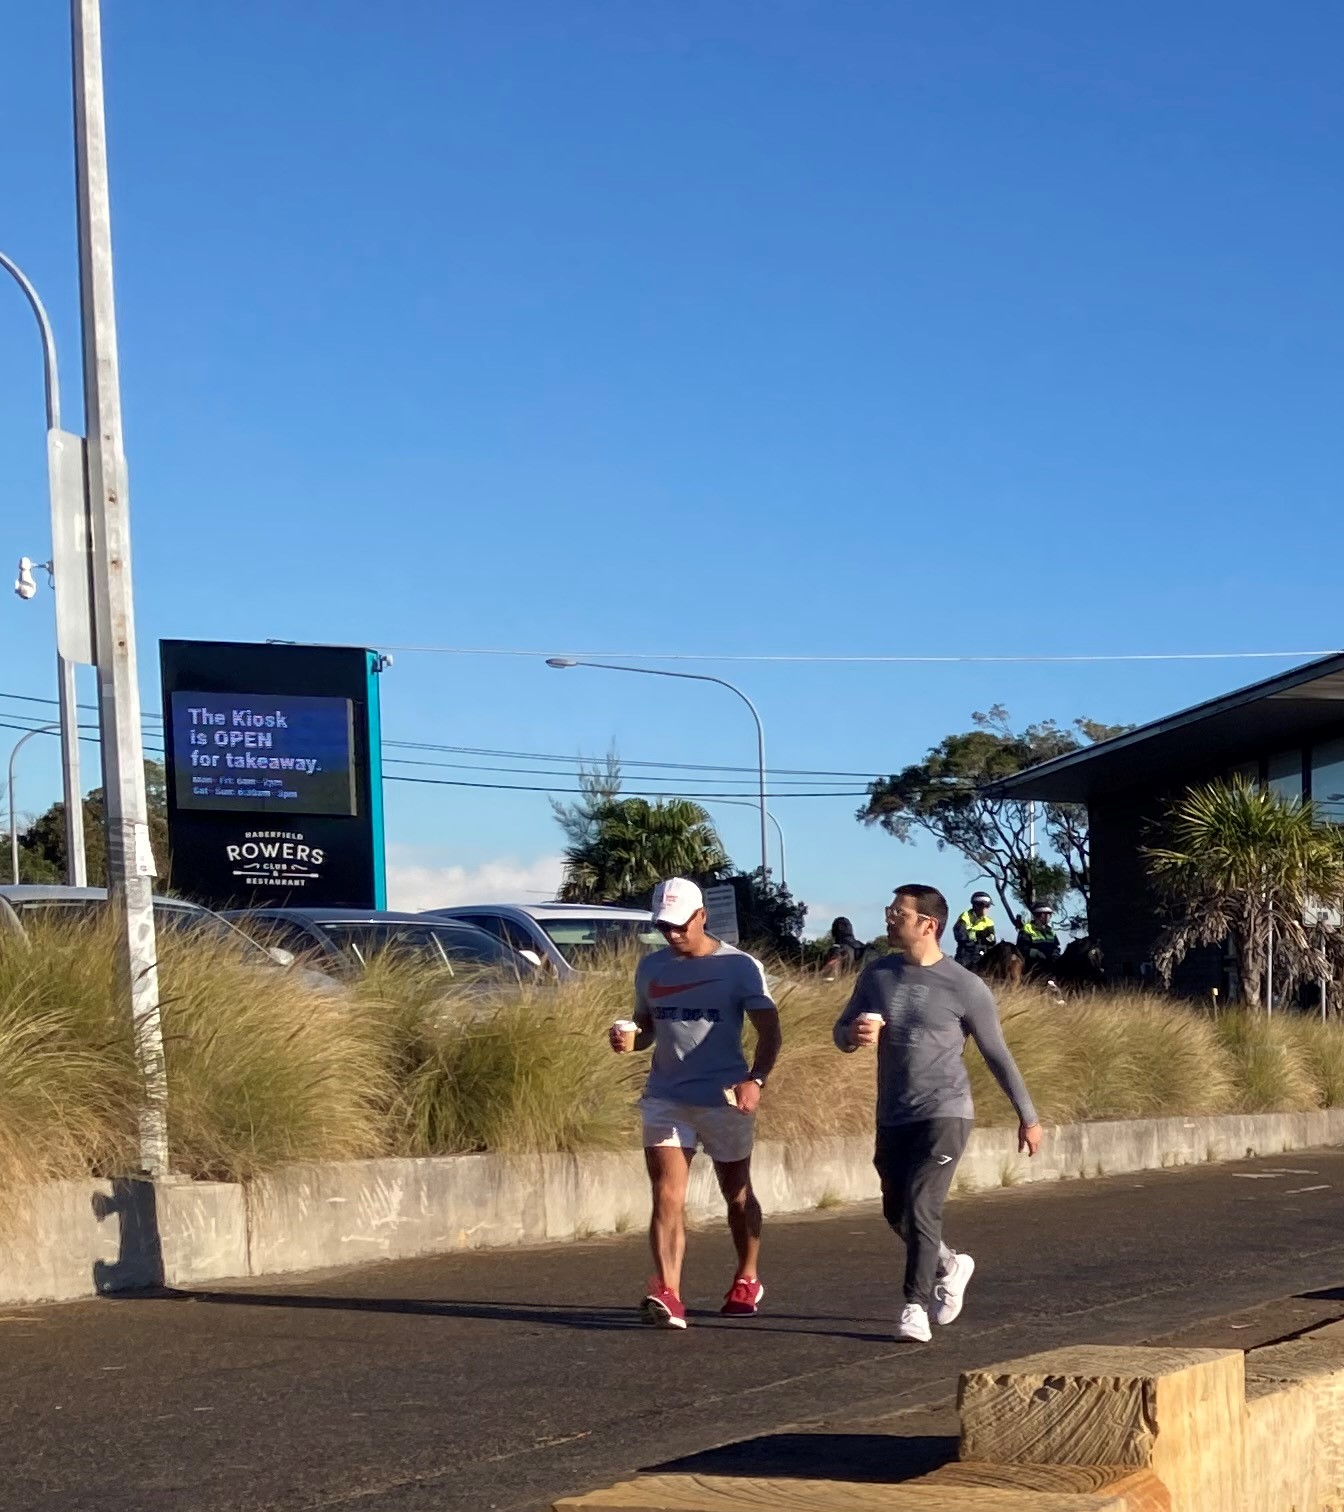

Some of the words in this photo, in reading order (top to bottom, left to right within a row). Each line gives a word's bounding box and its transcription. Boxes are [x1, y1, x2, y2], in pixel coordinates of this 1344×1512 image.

[188, 708, 226, 726] The
[232, 710, 288, 728] Kiosk
[190, 729, 207, 745] is
[214, 731, 273, 749] OPEN
[190, 749, 219, 768] for
[226, 753, 322, 775] takeaway.
[244, 831, 304, 840] HABERFIELD
[226, 842, 325, 865] ROWERS
[262, 862, 288, 870] CLUB
[245, 877, 306, 886] RESTAURANT
